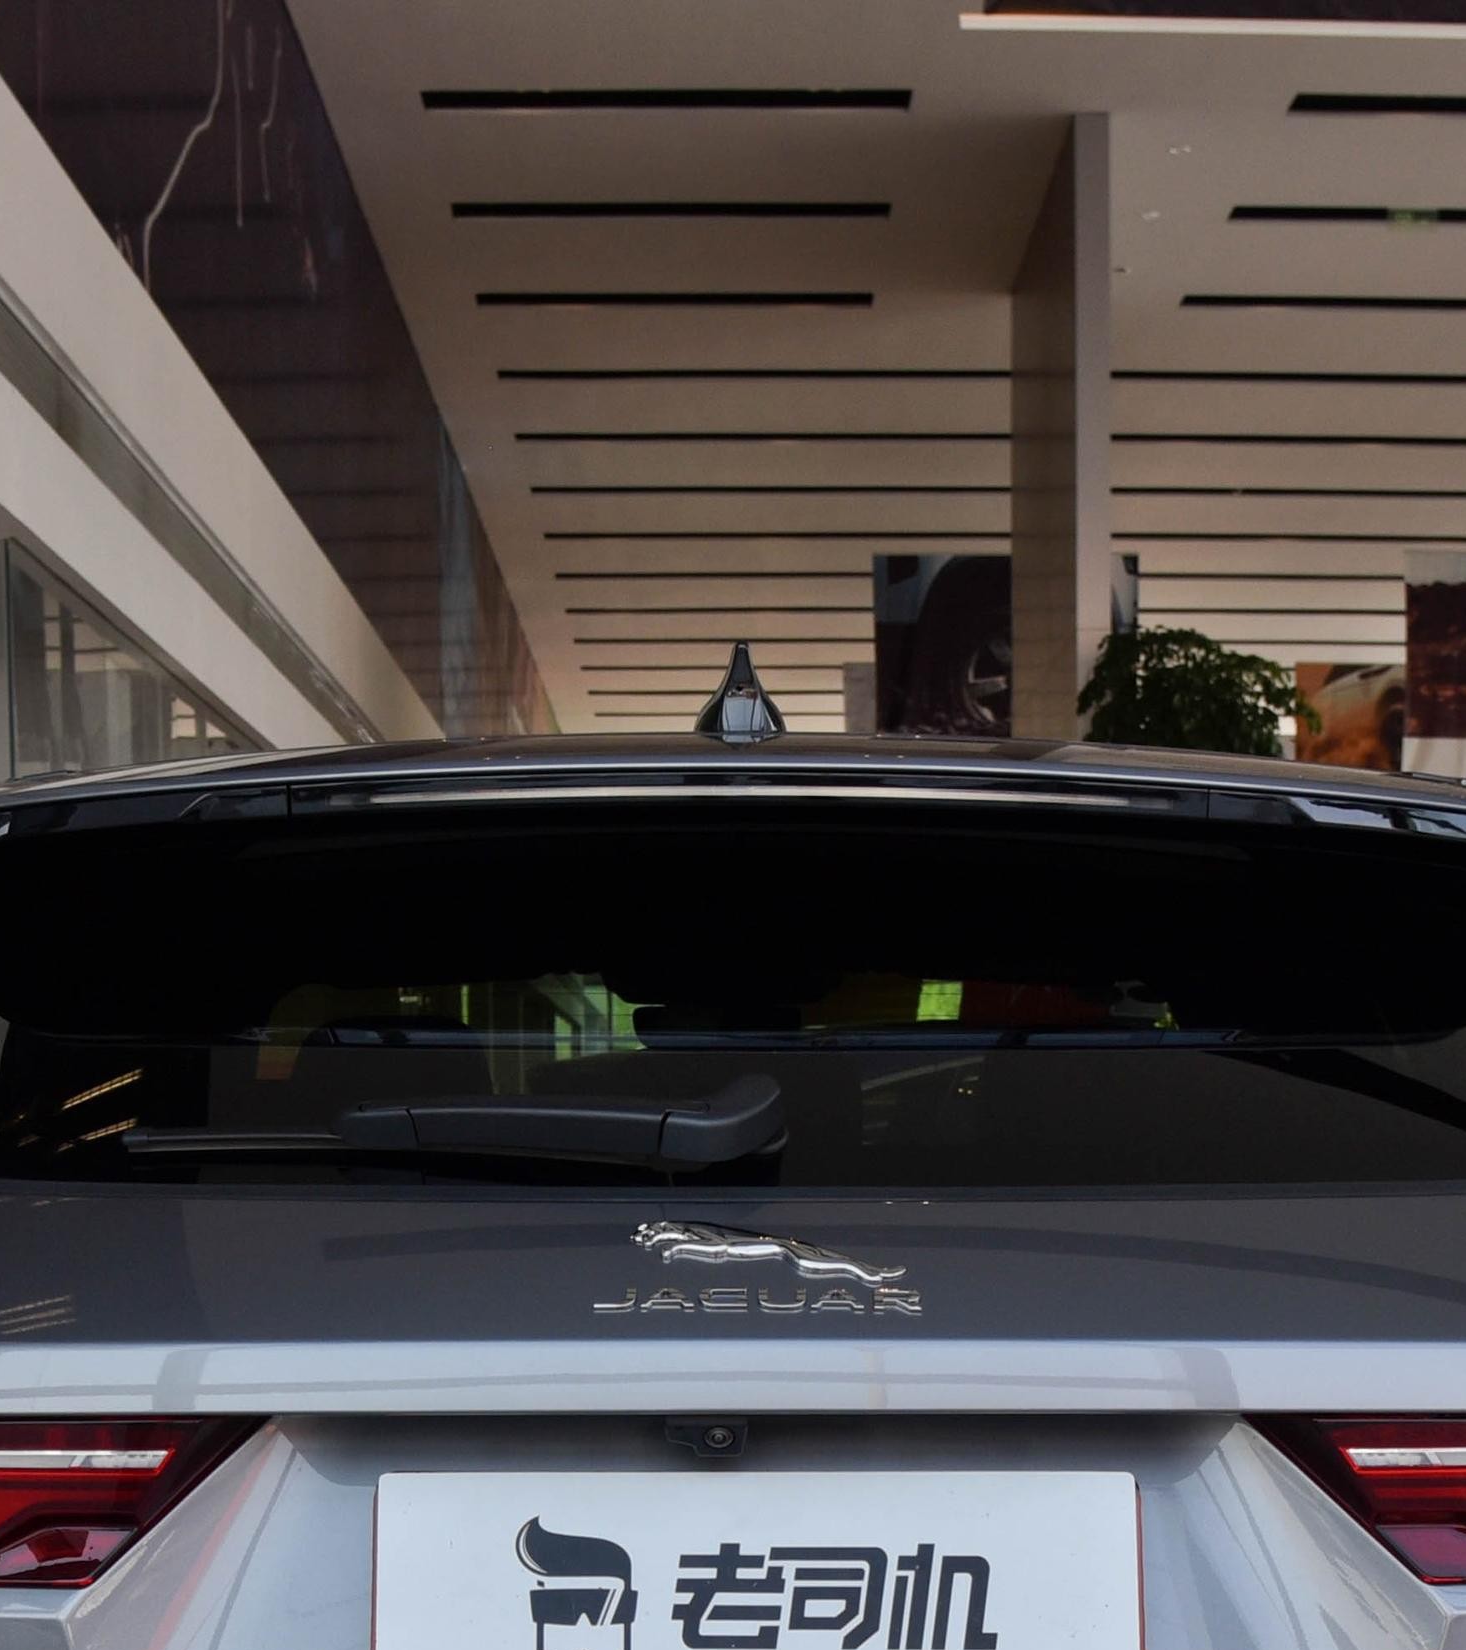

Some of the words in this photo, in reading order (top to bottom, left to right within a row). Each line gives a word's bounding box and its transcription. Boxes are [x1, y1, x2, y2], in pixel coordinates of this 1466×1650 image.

[592, 1286, 922, 1315] JAGUAR
[672, 1542, 998, 1650] 老司机
